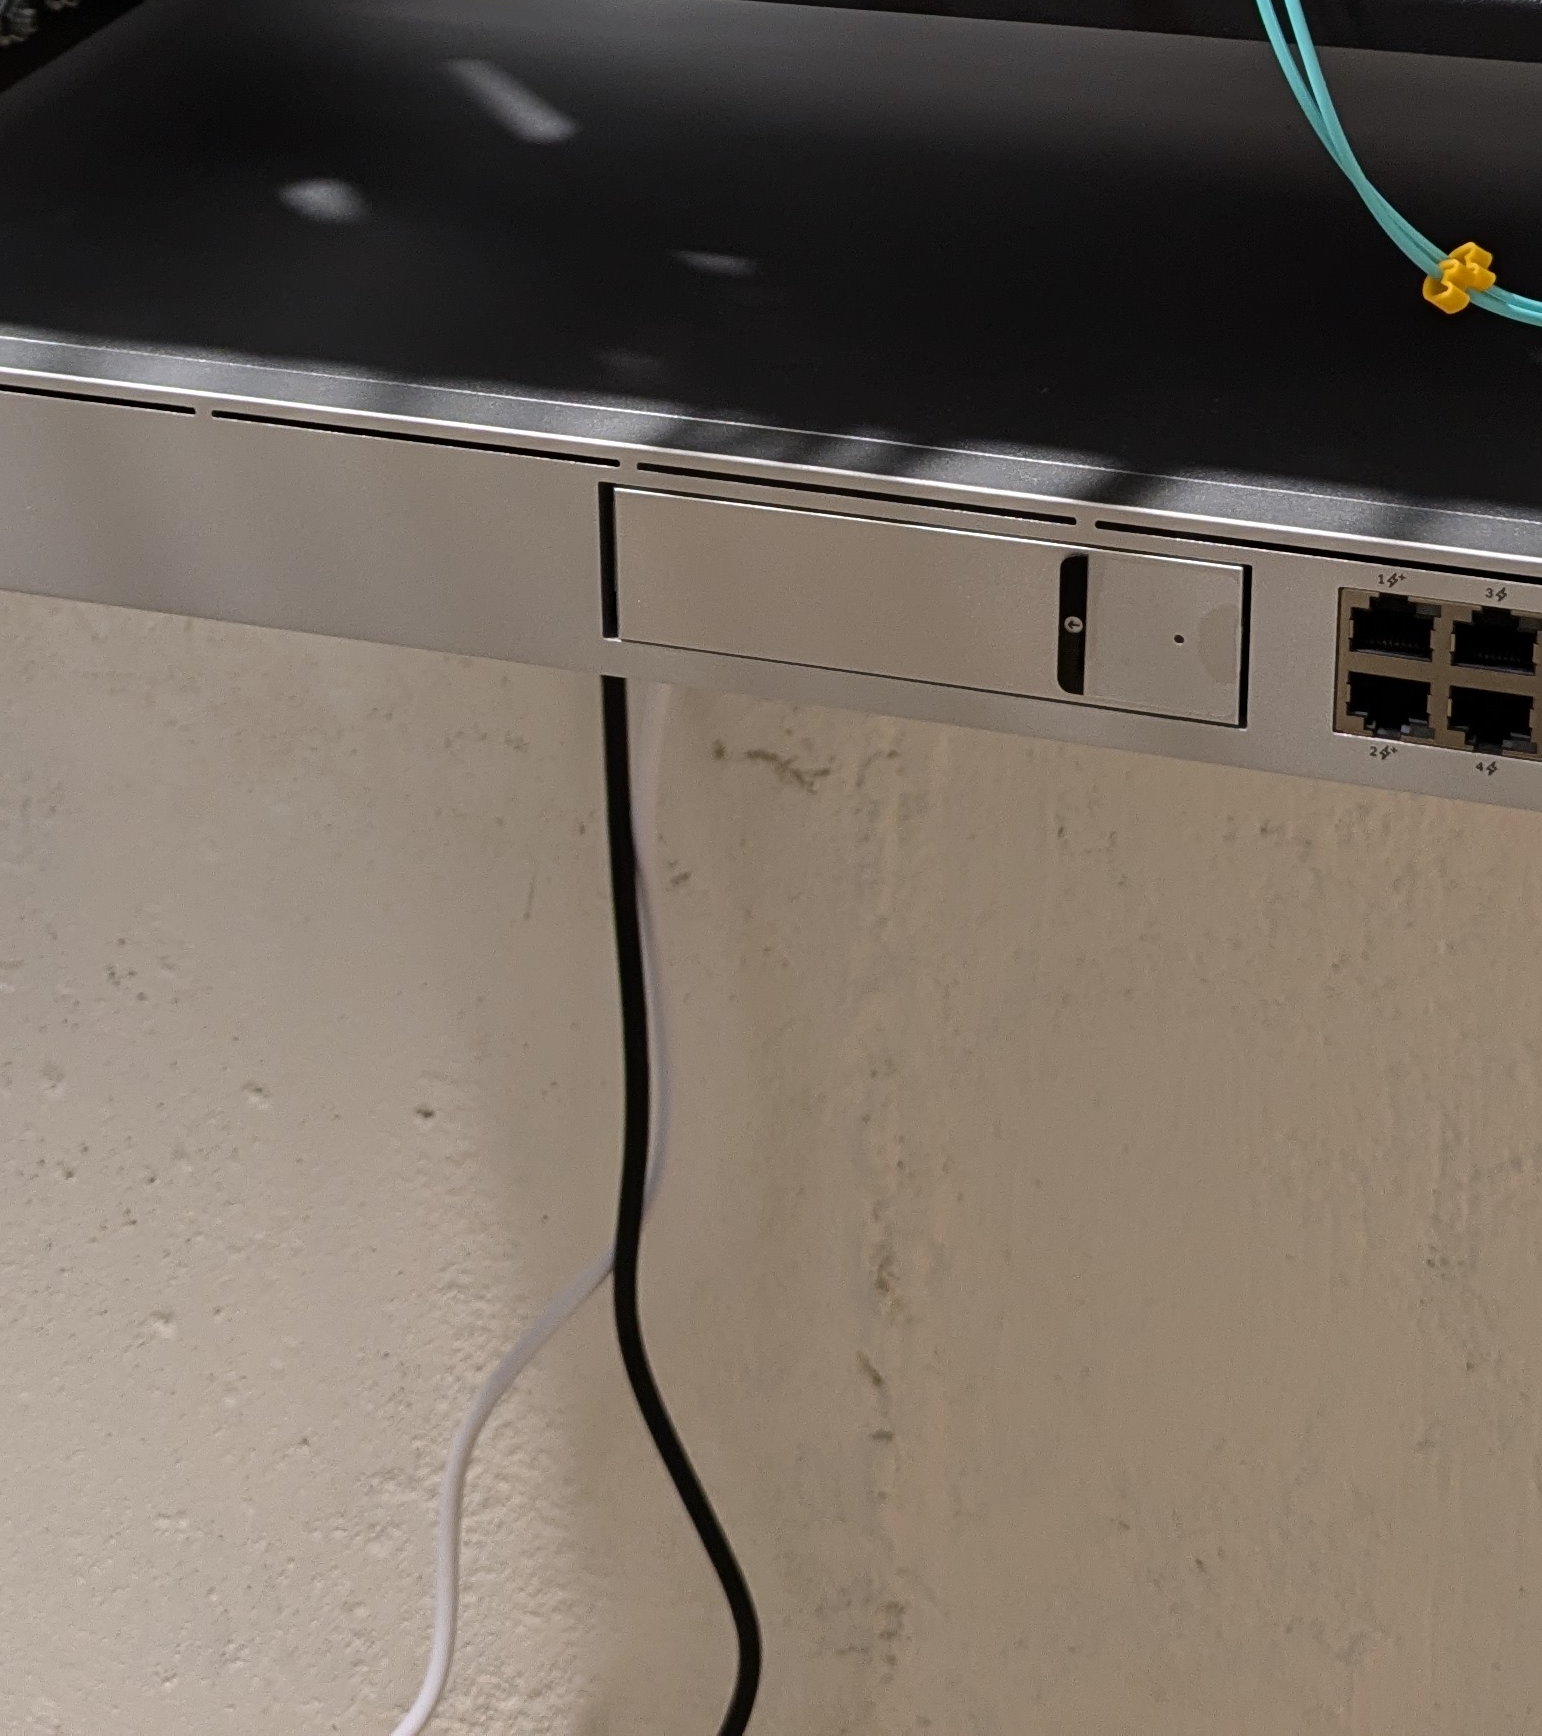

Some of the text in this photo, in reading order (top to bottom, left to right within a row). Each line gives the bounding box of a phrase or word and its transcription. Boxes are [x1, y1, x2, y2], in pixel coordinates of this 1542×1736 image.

[1377, 573, 1384, 585] 1
[1485, 587, 1493, 599] 3
[1369, 746, 1379, 757] 2
[1475, 762, 1484, 772] 4
